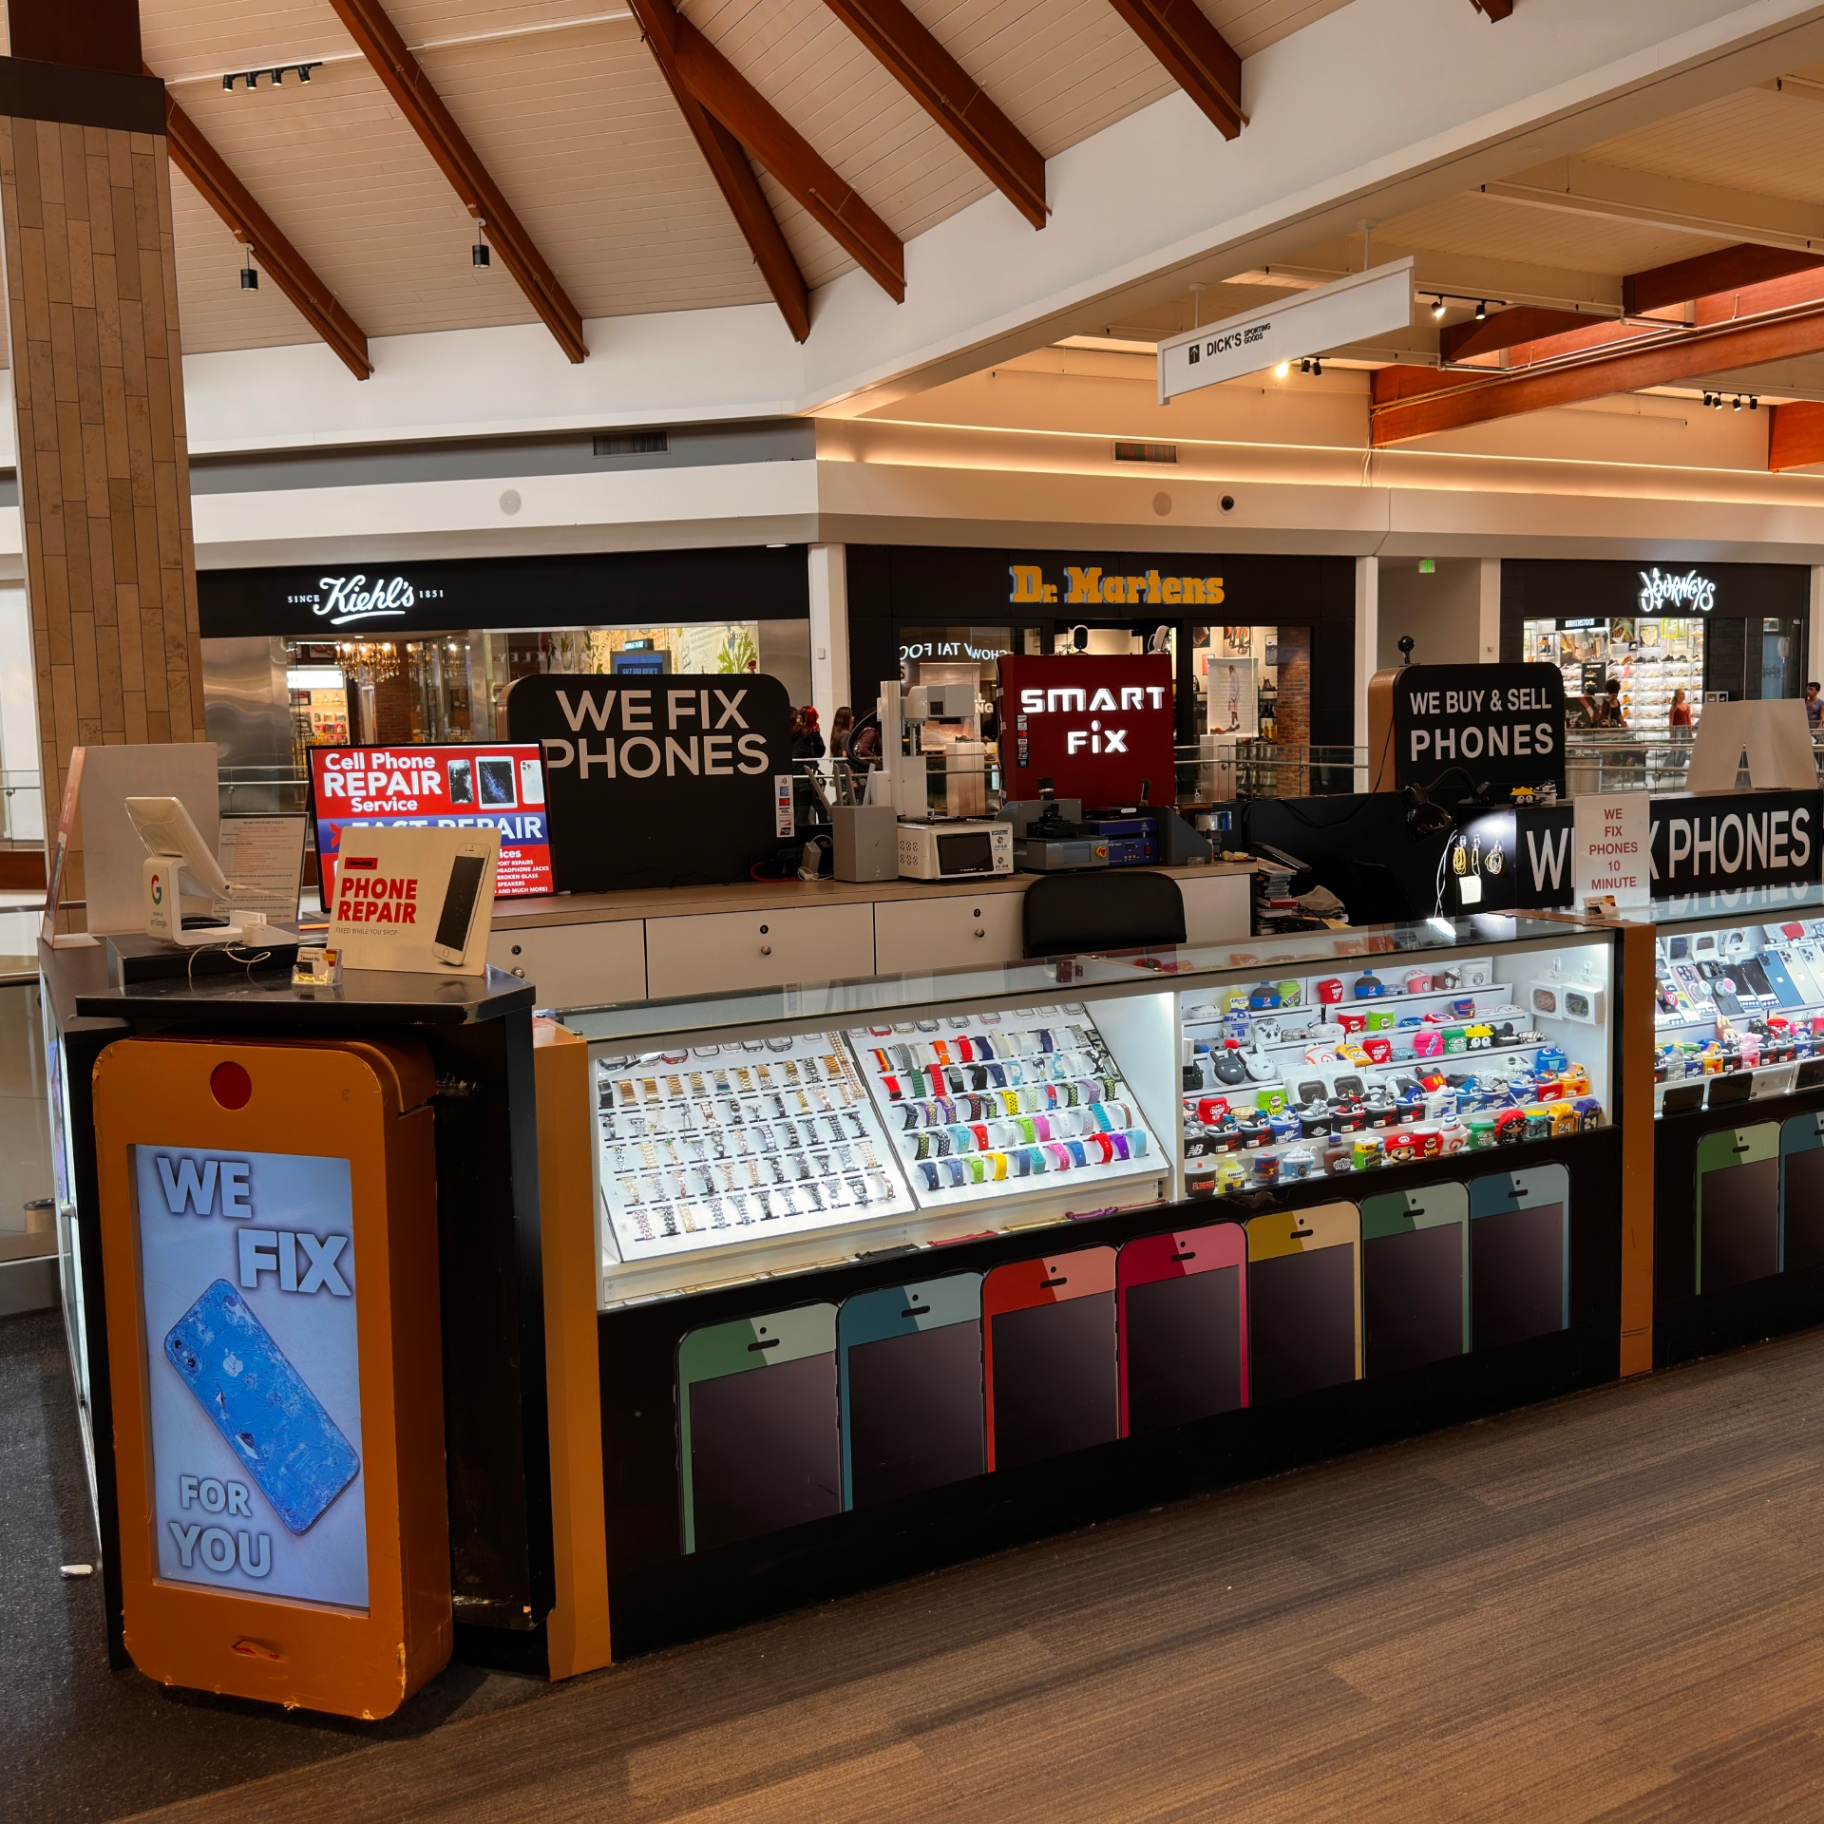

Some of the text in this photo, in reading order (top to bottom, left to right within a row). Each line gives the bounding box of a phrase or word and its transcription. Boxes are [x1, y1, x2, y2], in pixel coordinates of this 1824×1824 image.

[1244, 322, 1271, 338] SPORTING
[1244, 332, 1264, 344] GOODS
[1207, 333, 1242, 357] DICK'S
[287, 574, 444, 618] SINCE Kiehl's 1851
[1063, 566, 1225, 604] Martens
[1637, 567, 1716, 613] JOURNEYS
[555, 689, 750, 732] WE FIX
[1020, 686, 1166, 713] SMART
[1410, 688, 1552, 715] WE BUY & SELL
[1410, 723, 1554, 761] PHONES
[325, 752, 436, 770] Cell Phone
[541, 733, 770, 779] PHONES
[323, 770, 443, 797] REPAIR
[351, 796, 418, 812] Service
[1604, 808, 1623, 820] WE
[1604, 825, 1623, 837] FIX
[1669, 807, 1811, 878] PHONES
[1526, 827, 1574, 892] W
[1589, 842, 1638, 855] PHONES
[1608, 861, 1621, 872] 10
[340, 877, 418, 900] PHONE
[1591, 876, 1637, 890] MINUTE
[337, 900, 416, 924] REPAIR
[370, 928, 382, 936] YOU
[1559, 1122, 1571, 1134] 24
[1584, 1117, 1597, 1130] 24
[156, 1155, 253, 1219] WE
[238, 1228, 353, 1298] FIX
[180, 1475, 252, 1518] FOR
[169, 1521, 273, 1578] YOU
